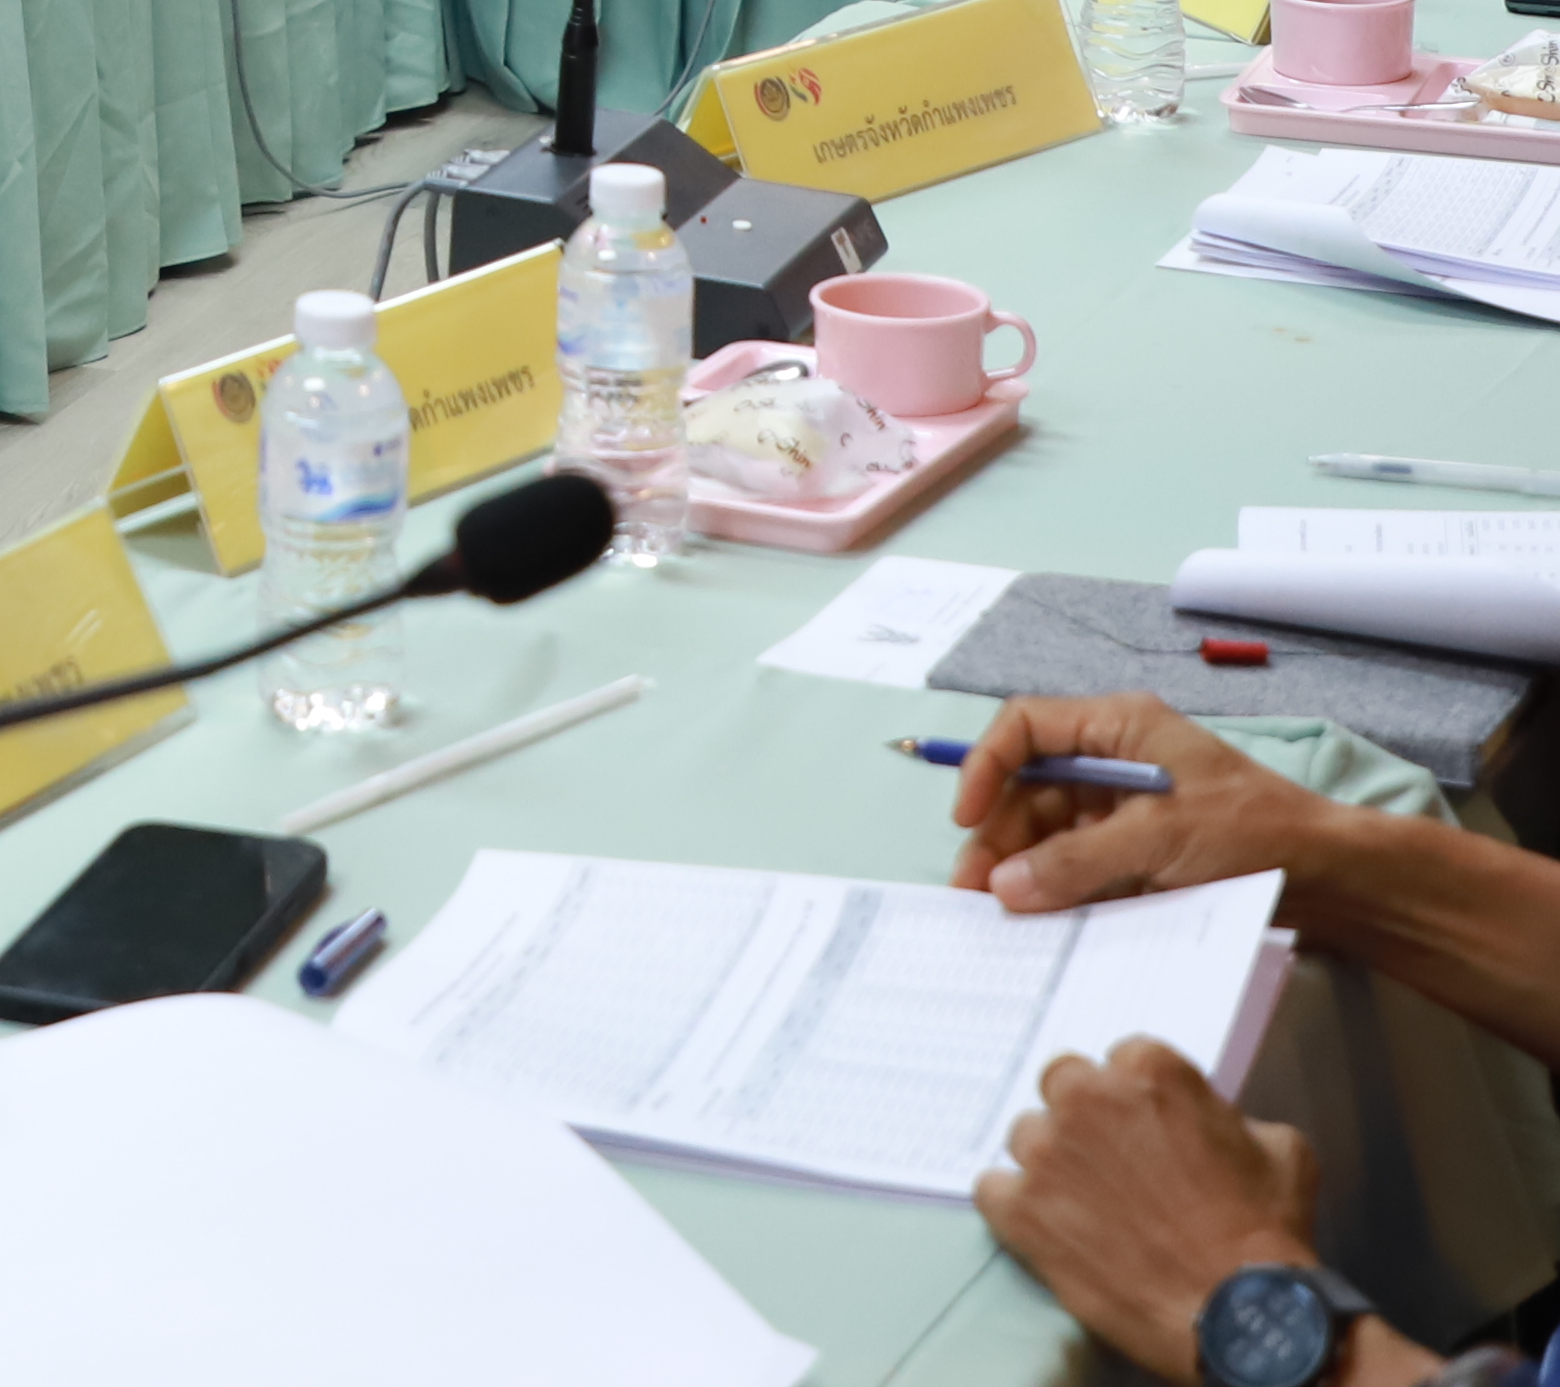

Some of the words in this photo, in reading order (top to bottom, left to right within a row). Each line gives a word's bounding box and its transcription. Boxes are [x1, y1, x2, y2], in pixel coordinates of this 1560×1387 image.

[813, 84, 1017, 164] เกษตรจังหวัดกำแพงเพชร
